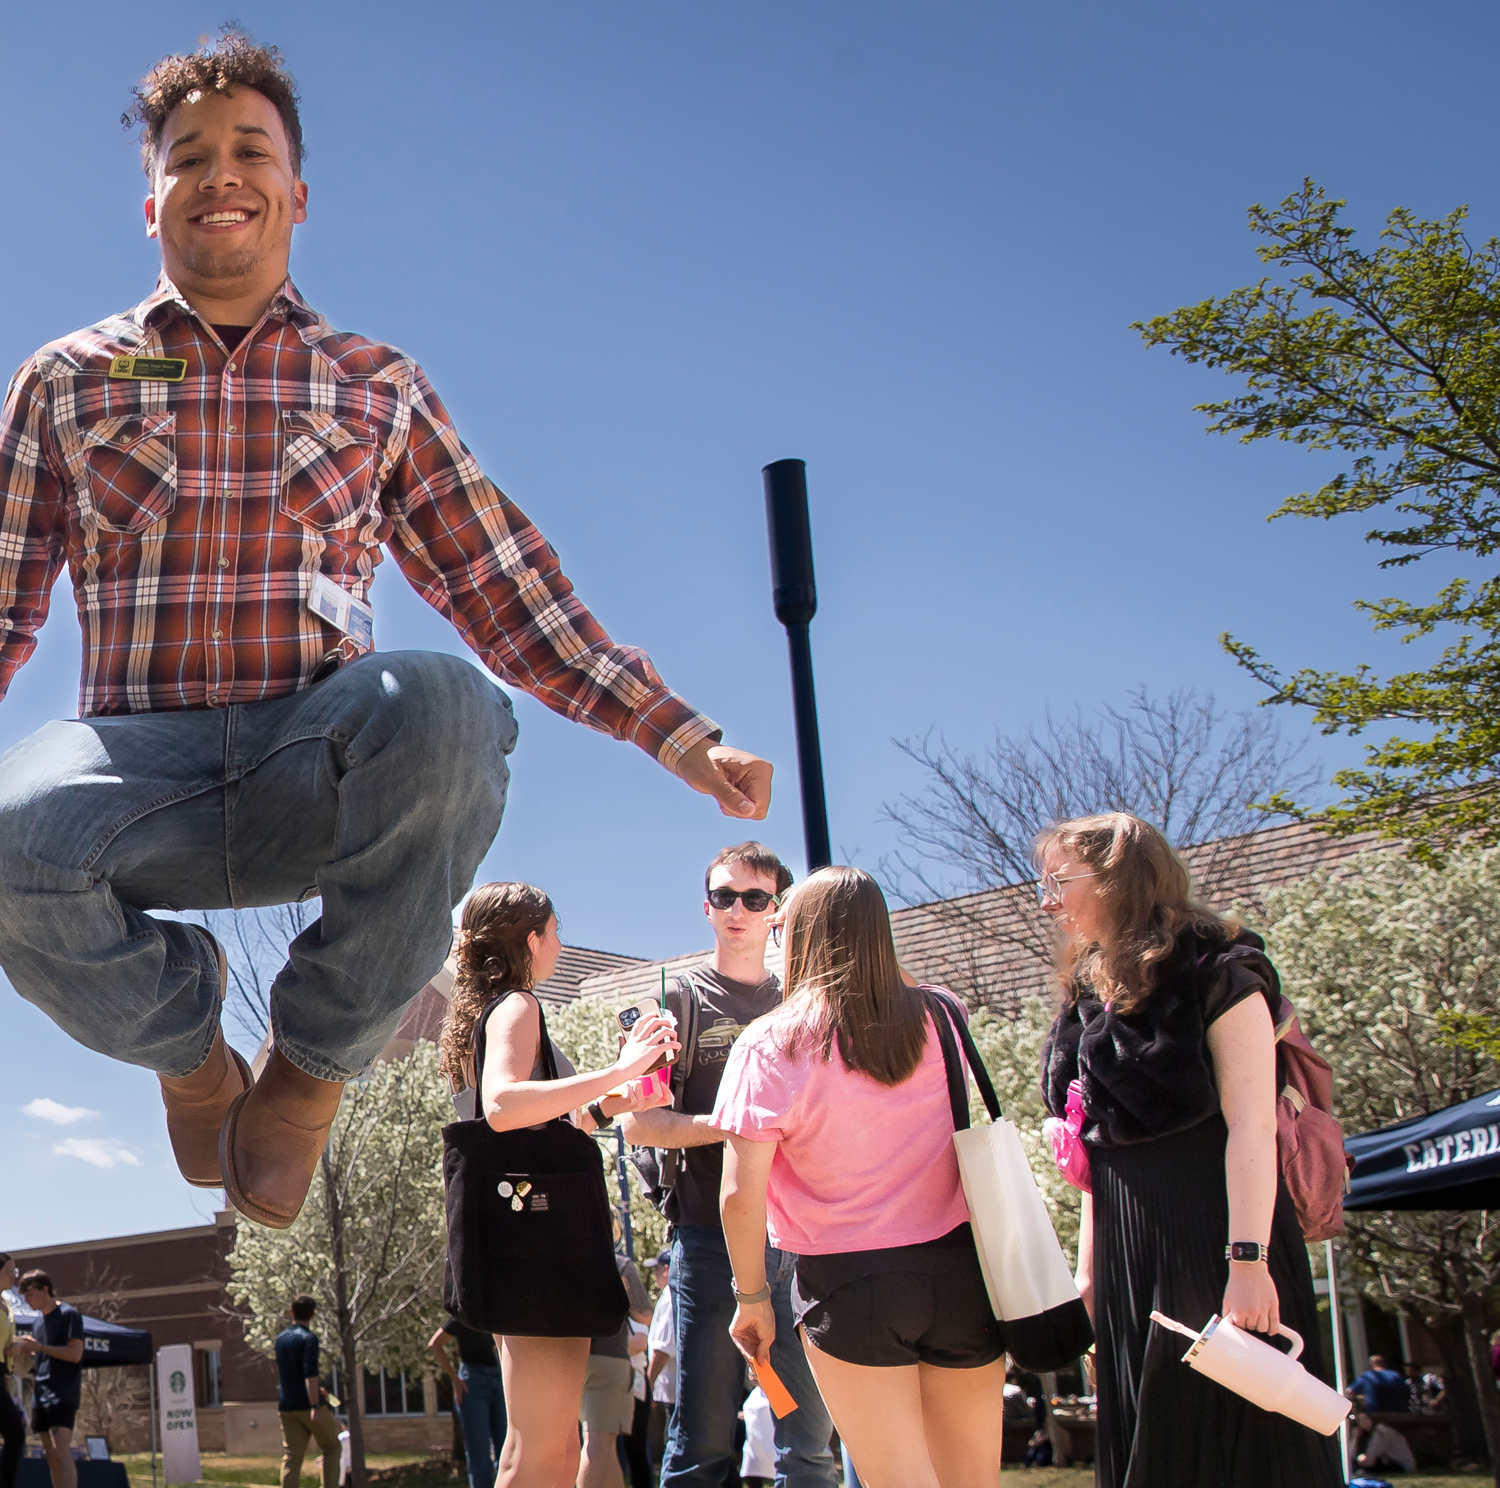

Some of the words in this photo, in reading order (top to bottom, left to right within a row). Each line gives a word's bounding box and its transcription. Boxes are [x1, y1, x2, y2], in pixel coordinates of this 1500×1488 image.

[1403, 1122, 1500, 1173] CATERI
[166, 1409, 192, 1419] NOW
[166, 1421, 193, 1431] OPEN
